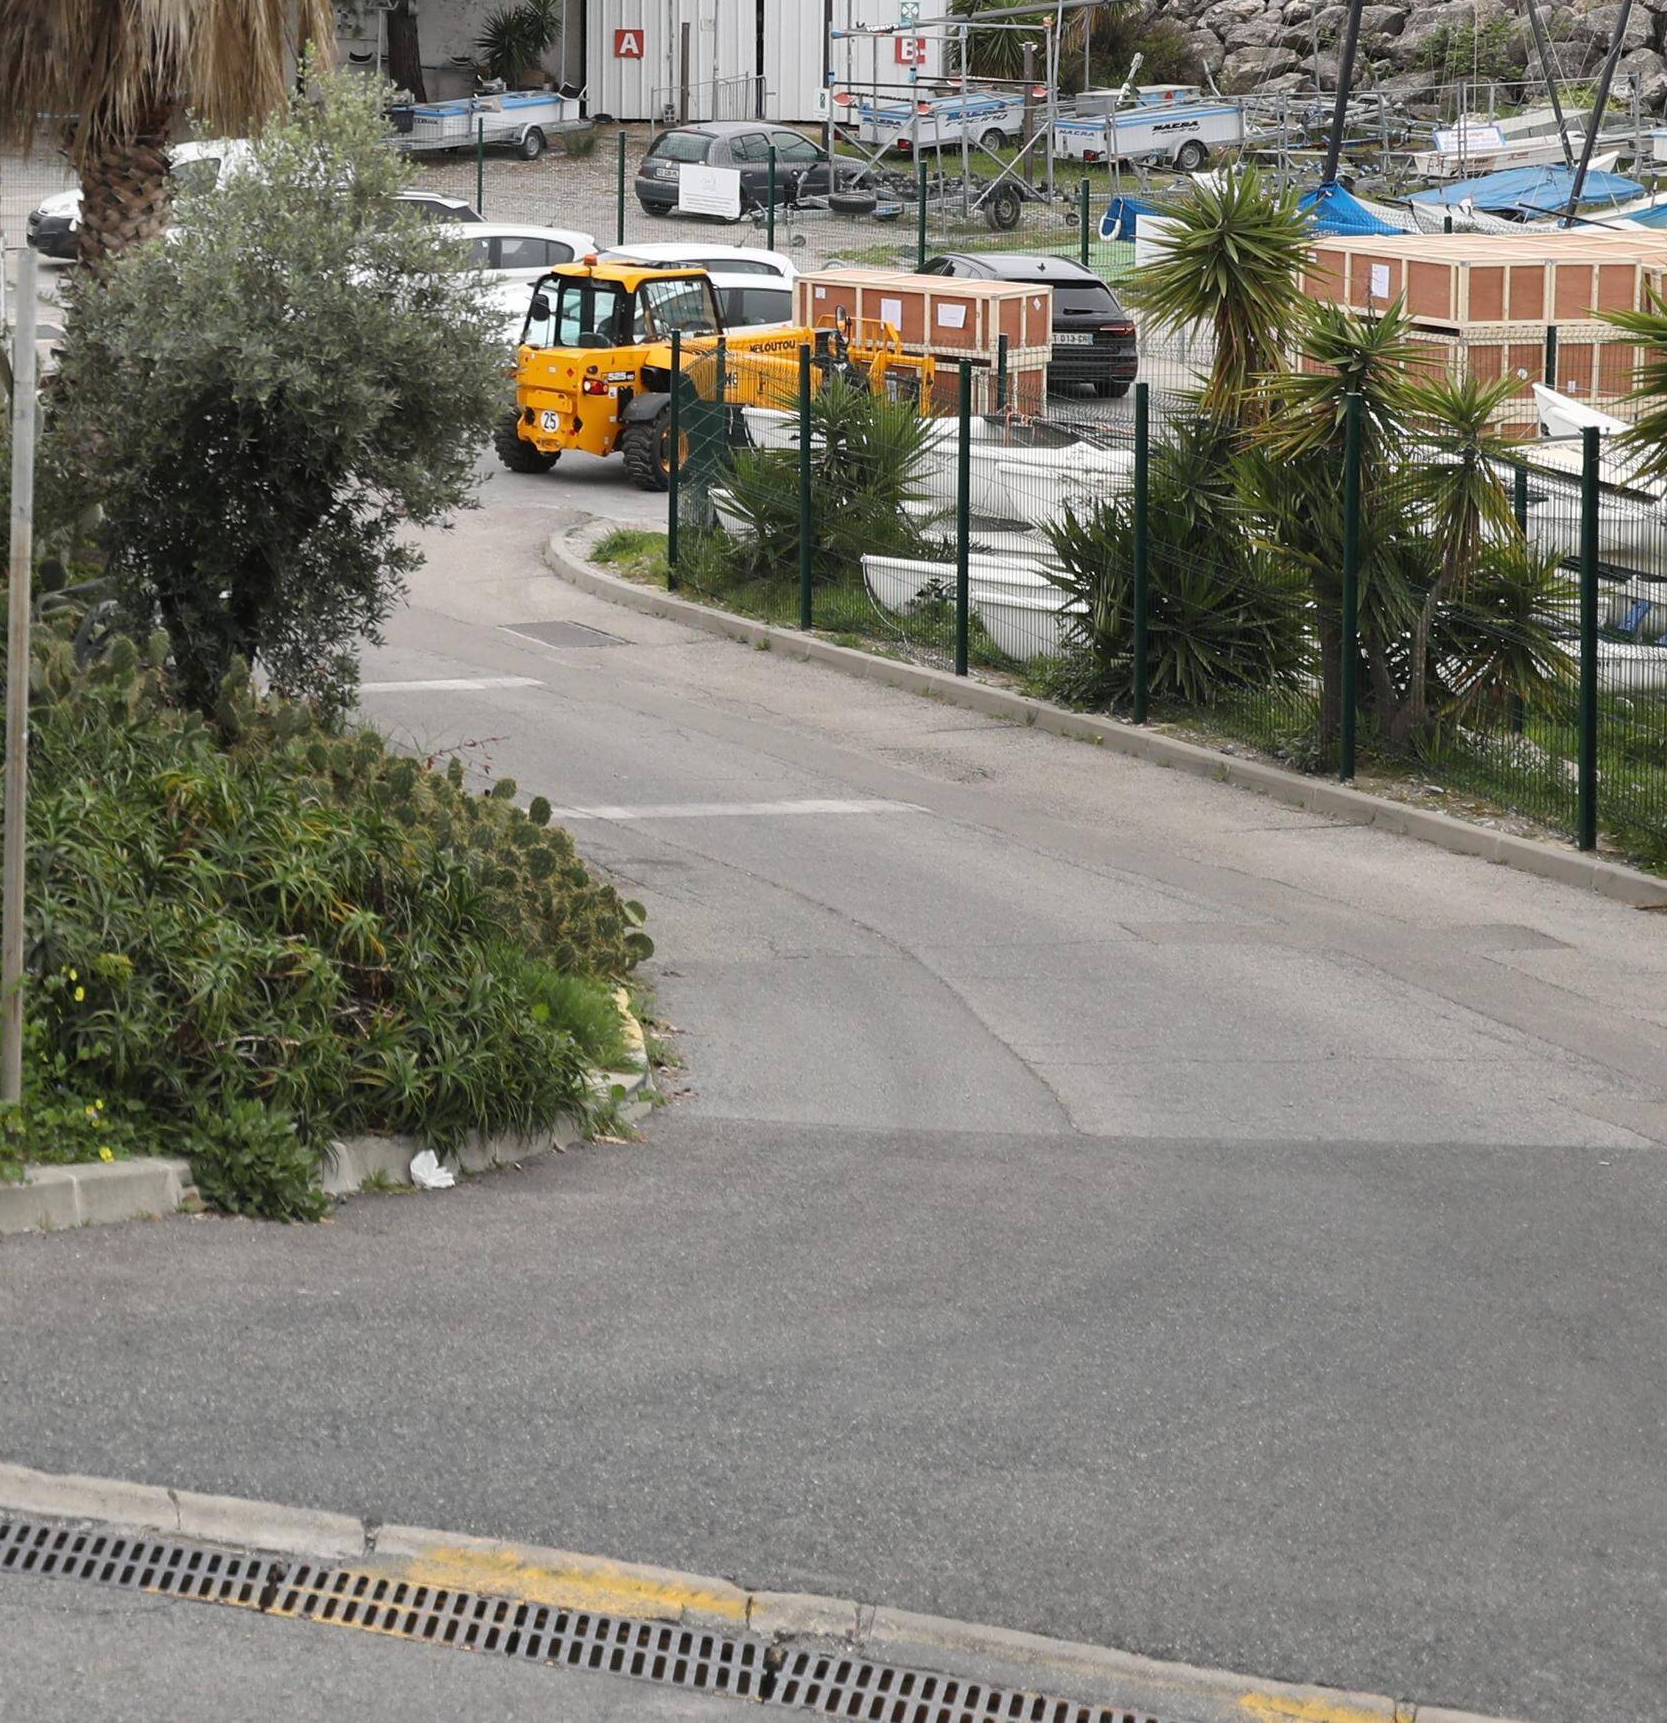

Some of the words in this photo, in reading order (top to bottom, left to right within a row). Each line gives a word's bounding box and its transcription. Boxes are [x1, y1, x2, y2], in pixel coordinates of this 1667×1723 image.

[619, 33, 639, 54] A
[901, 38, 919, 60] B
[544, 412, 556, 429] 25
